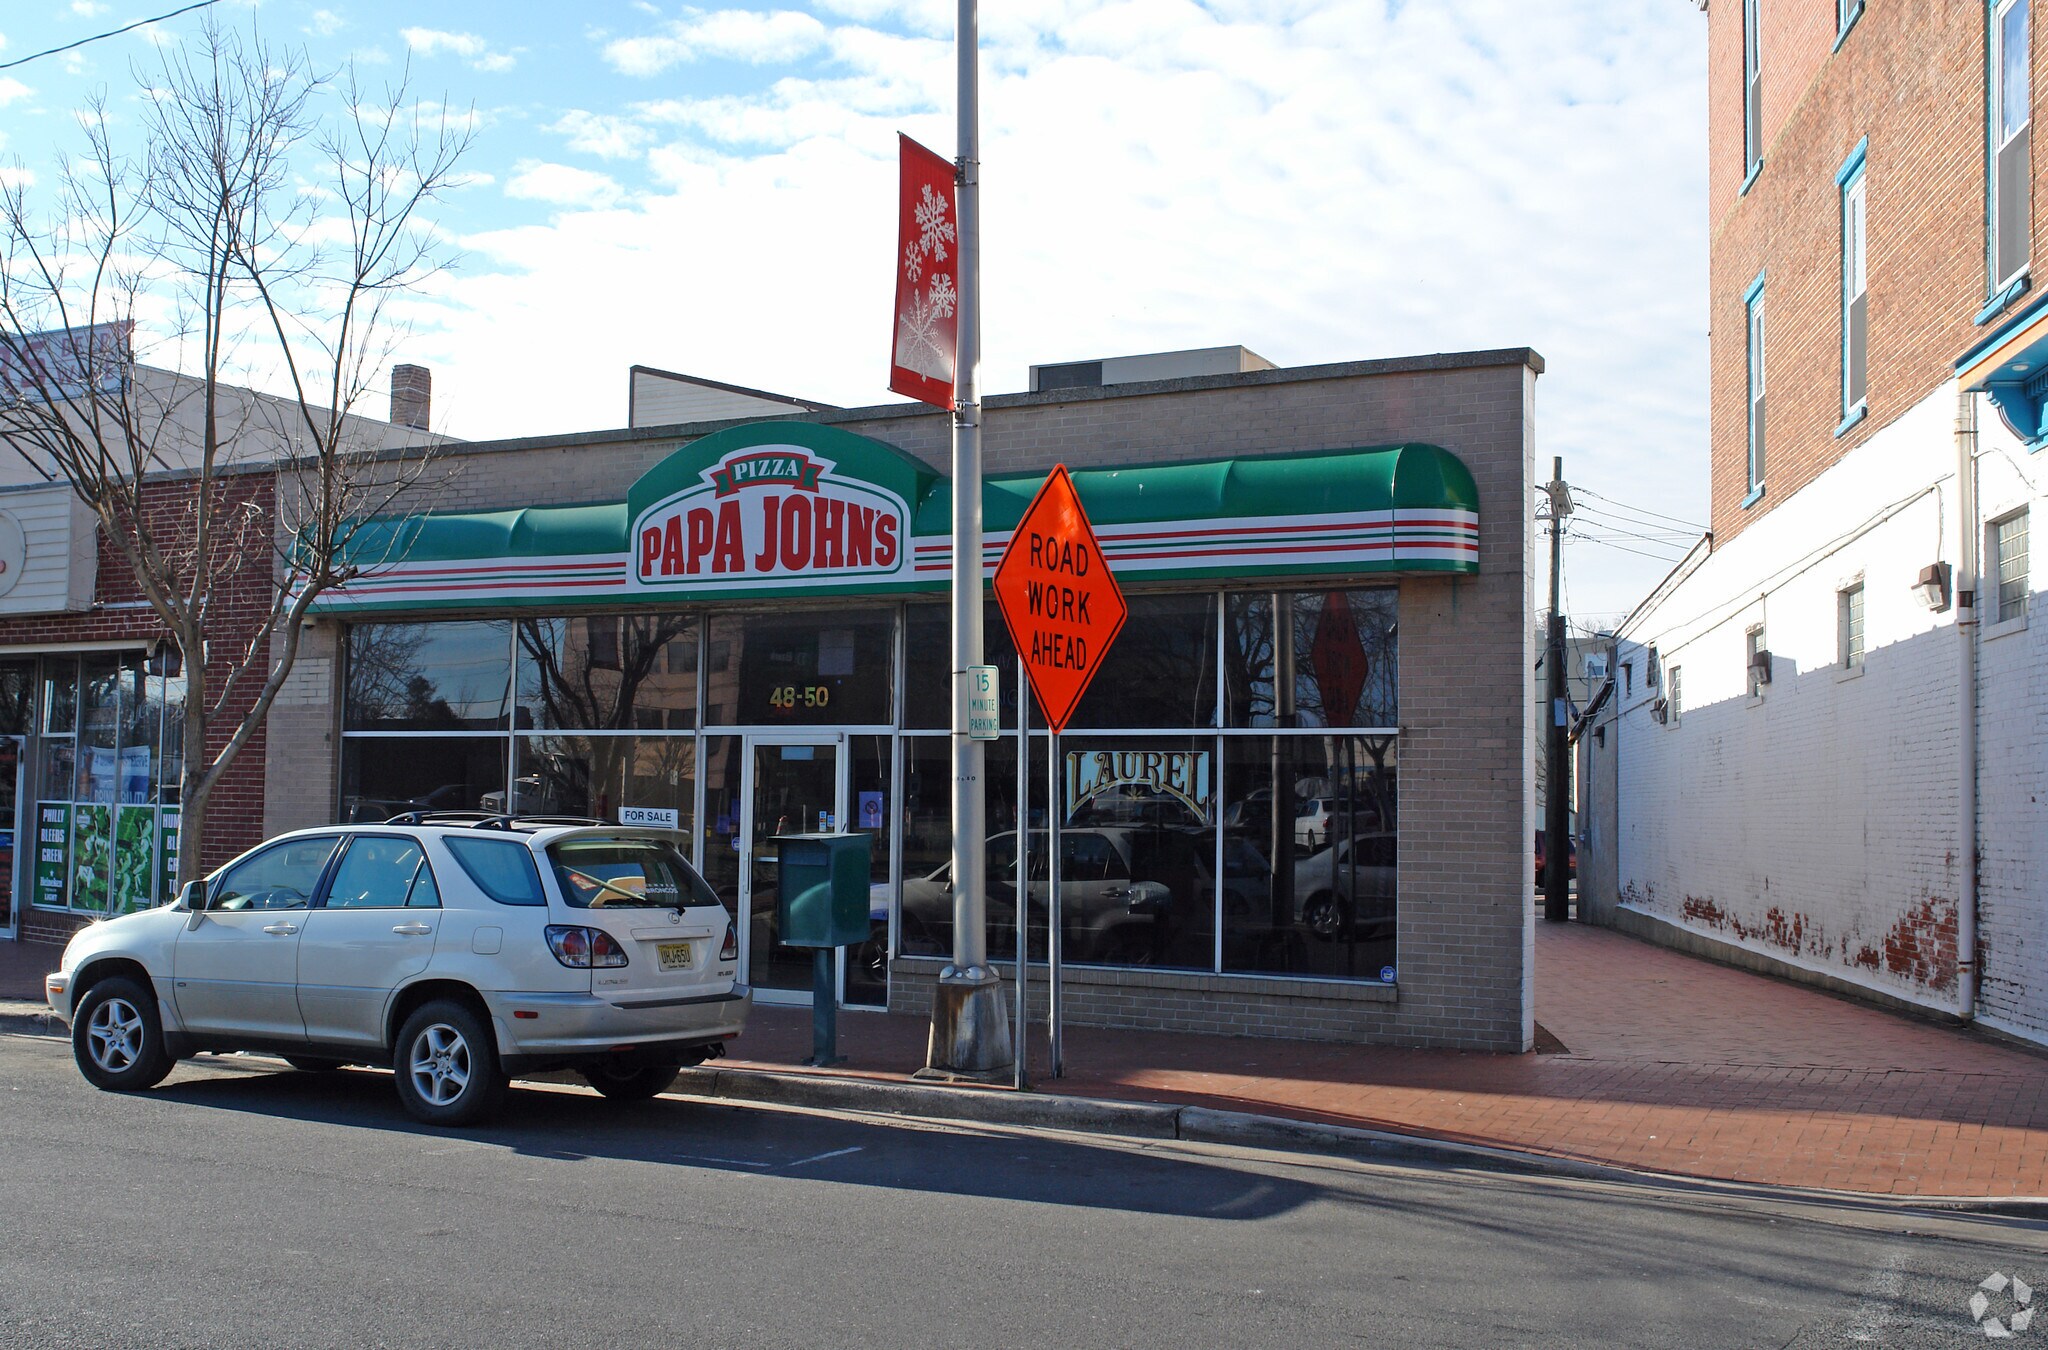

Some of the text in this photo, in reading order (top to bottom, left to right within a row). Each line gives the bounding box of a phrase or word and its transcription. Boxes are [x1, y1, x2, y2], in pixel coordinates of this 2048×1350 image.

[733, 459, 799, 481] PIZZA
[641, 493, 898, 577] PAPA JOHN'S
[1030, 532, 1090, 578] ROAD
[1028, 580, 1092, 625] WORK
[1030, 629, 1088, 671] AHEAD
[975, 673, 990, 693] 15
[769, 686, 830, 709] 48-50
[971, 697, 996, 712] MINUTE
[970, 717, 998, 732] PARKING
[1069, 751, 1209, 809] LAUREL
[42, 808, 66, 823] PHILLY
[162, 813, 180, 829] HUM
[624, 810, 672, 822] FOR SALE
[41, 828, 65, 843] BLEEDS
[42, 848, 63, 863] GREEN
